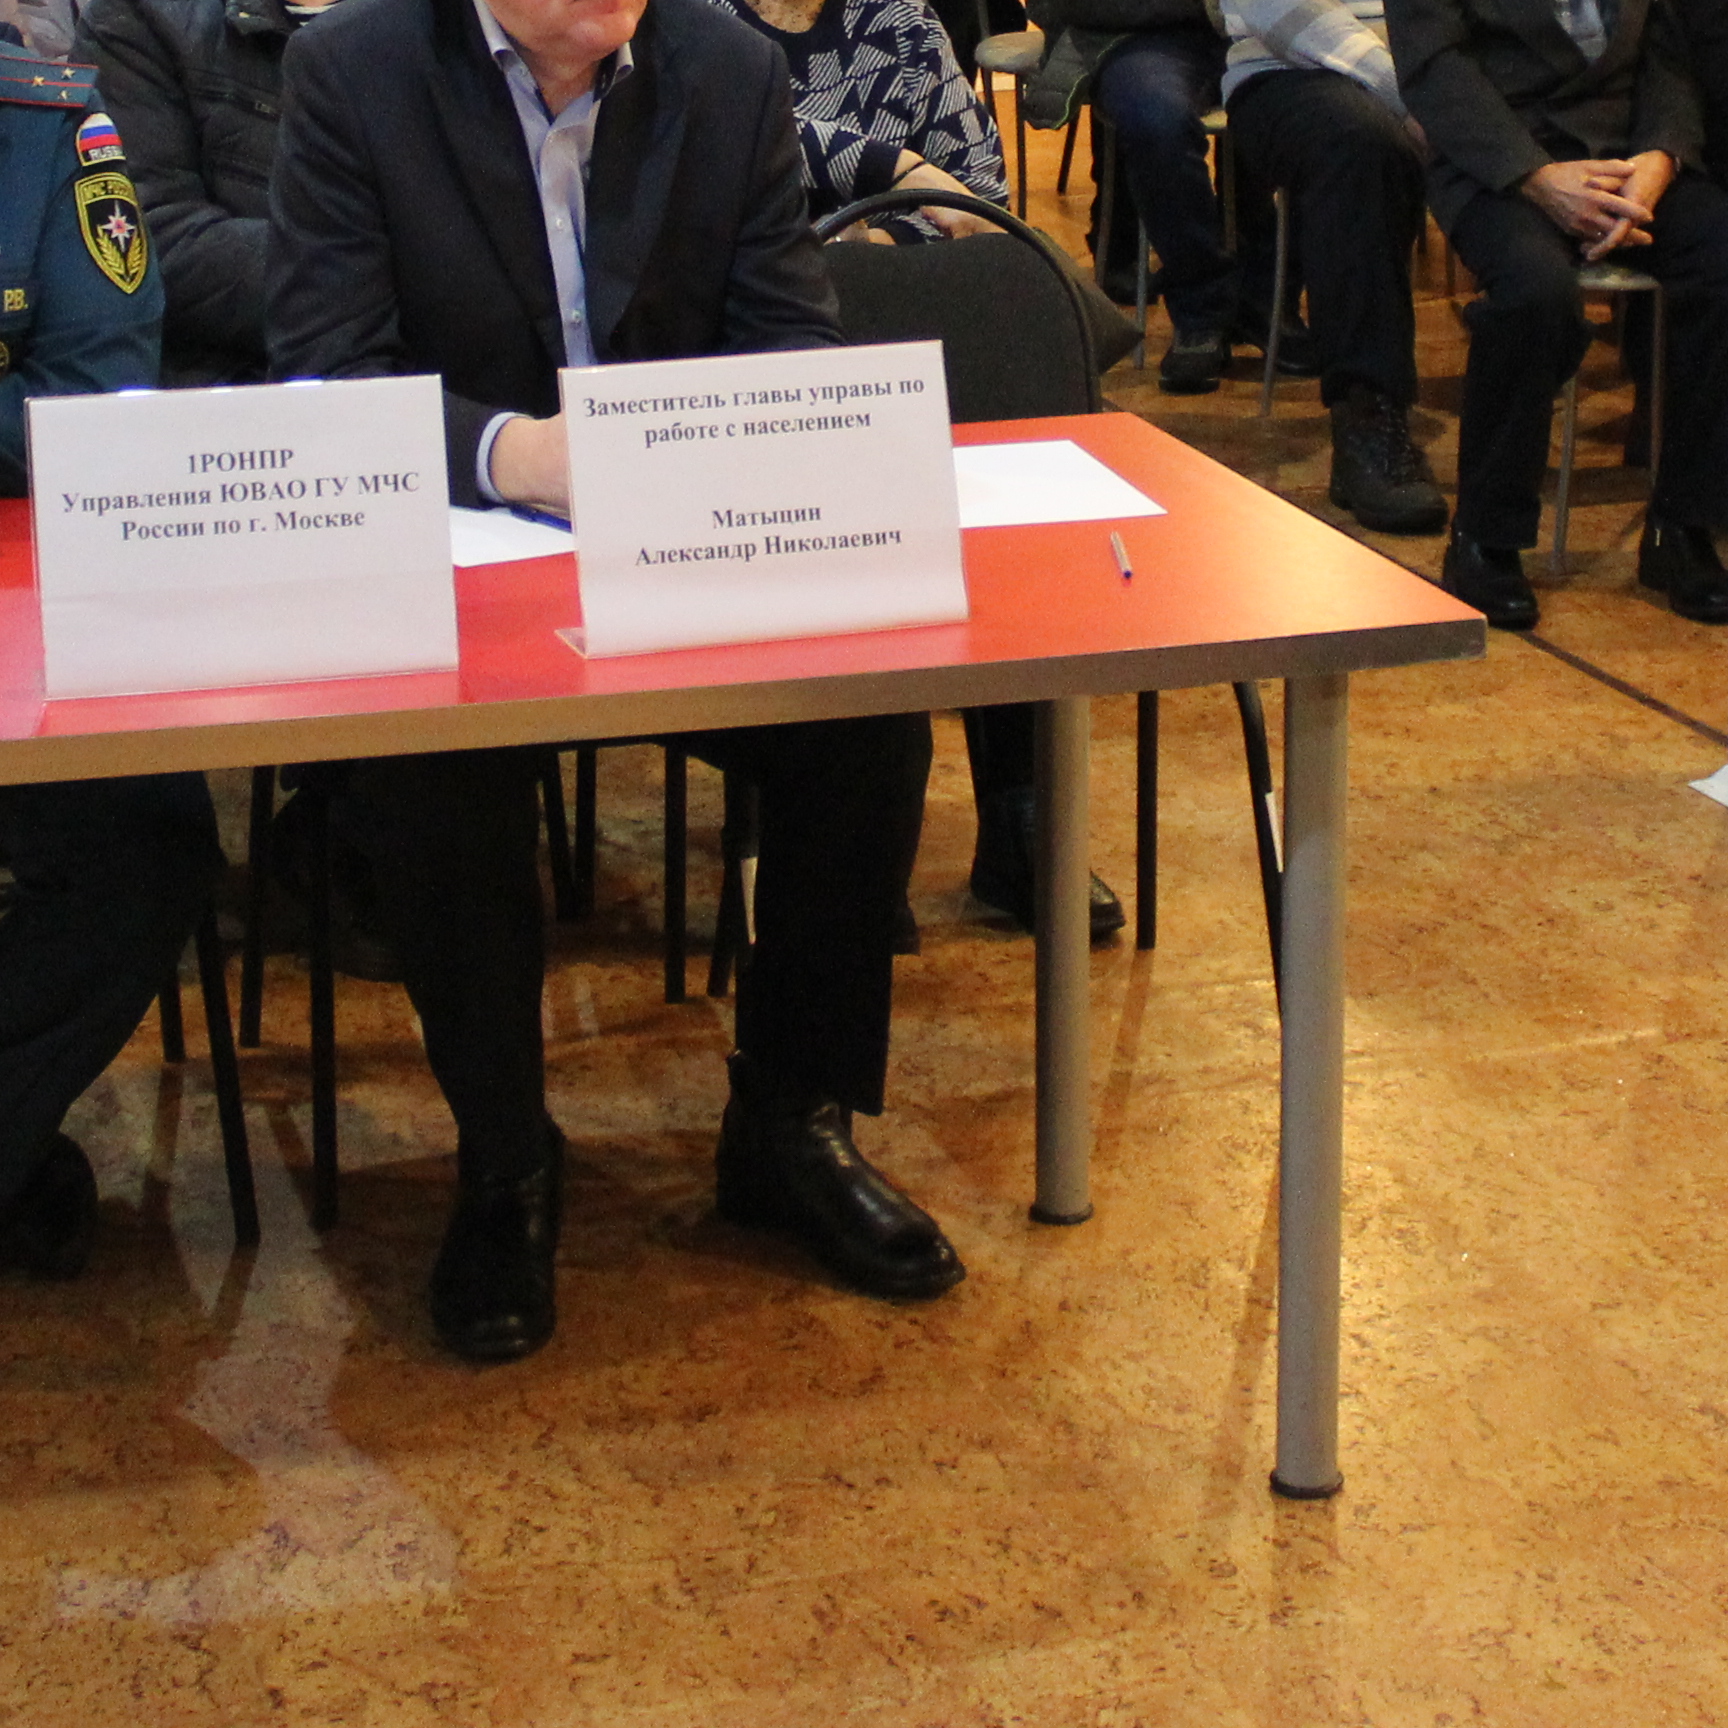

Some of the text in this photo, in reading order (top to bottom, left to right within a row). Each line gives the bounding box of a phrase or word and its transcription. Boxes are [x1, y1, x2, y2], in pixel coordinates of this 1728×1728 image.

[583, 378, 924, 418] Заместитель главы управы по
[644, 411, 871, 448] работе с населением
[188, 449, 294, 474] 1РОНПР
[62, 472, 420, 516] Управления ЮВАО ГУ МЧС
[121, 510, 365, 541] России по г. Москве
[712, 506, 822, 529] Матыцин
[635, 530, 902, 567] Александр Николаевич
